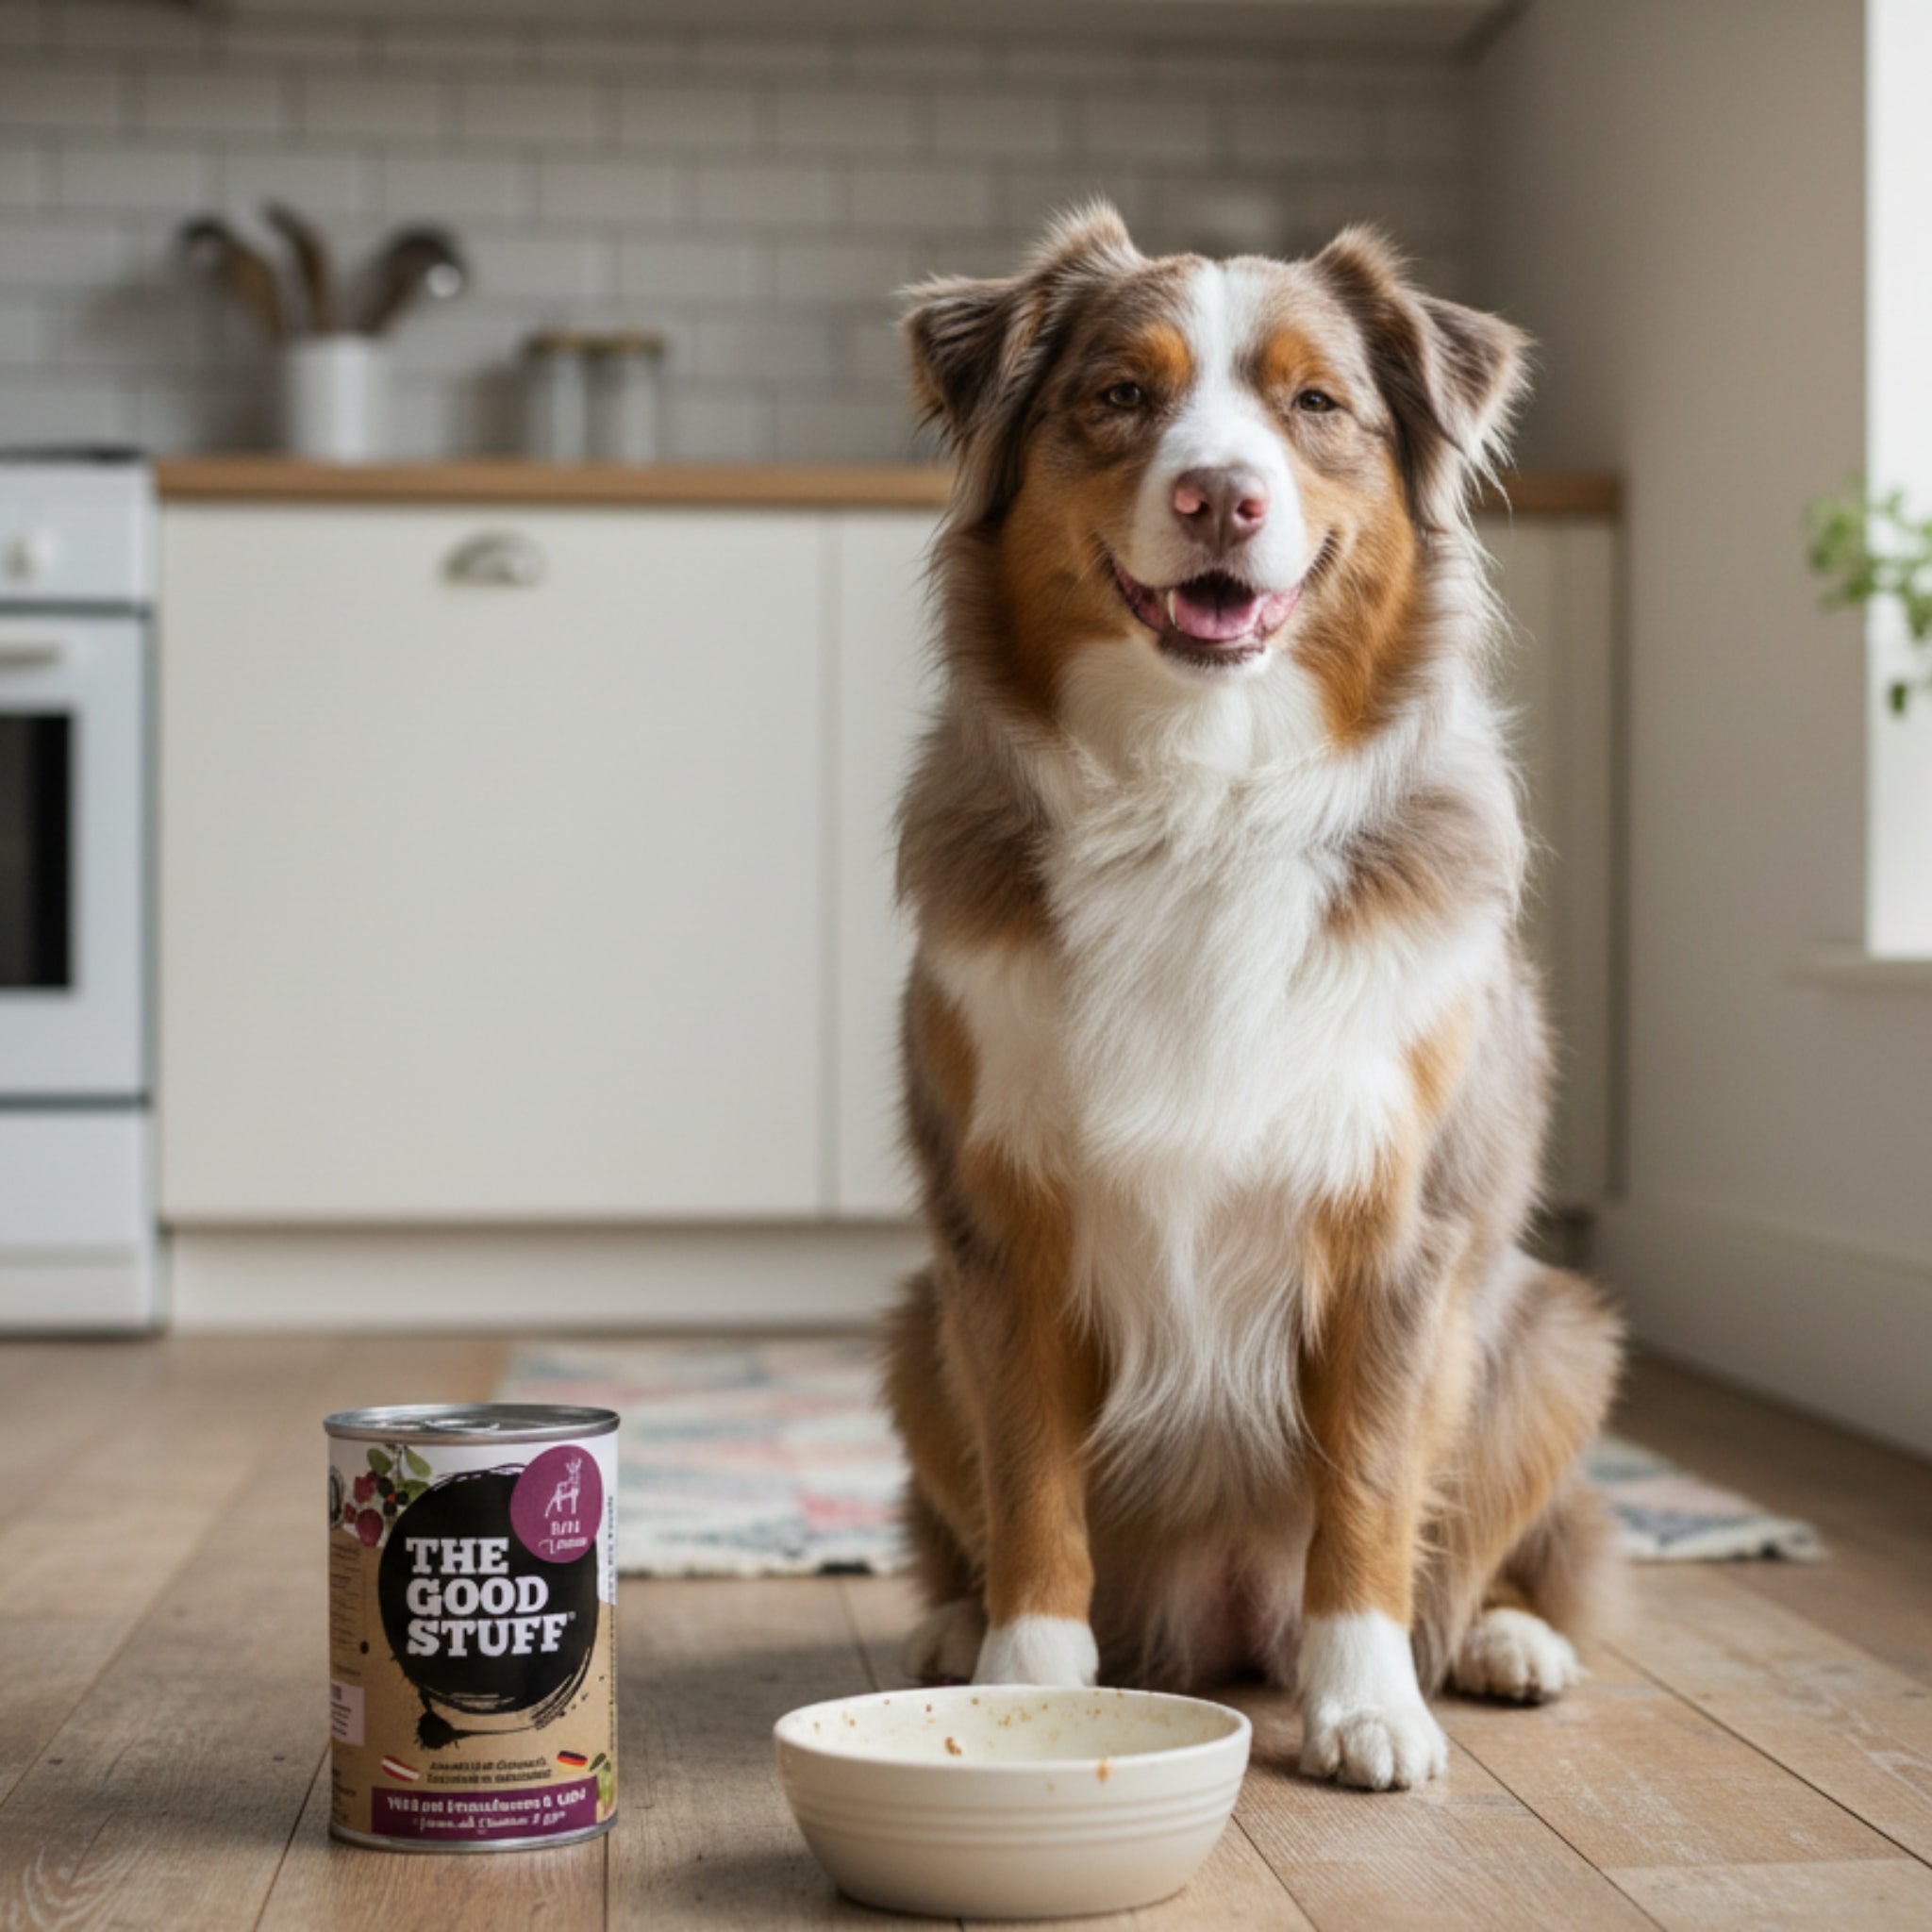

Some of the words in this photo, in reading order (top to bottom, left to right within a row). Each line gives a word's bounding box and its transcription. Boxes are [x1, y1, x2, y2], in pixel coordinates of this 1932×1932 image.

[406, 1537, 509, 1574] THE
[406, 1575, 549, 1617] GOOD
[407, 1613, 567, 1657] STUFF
